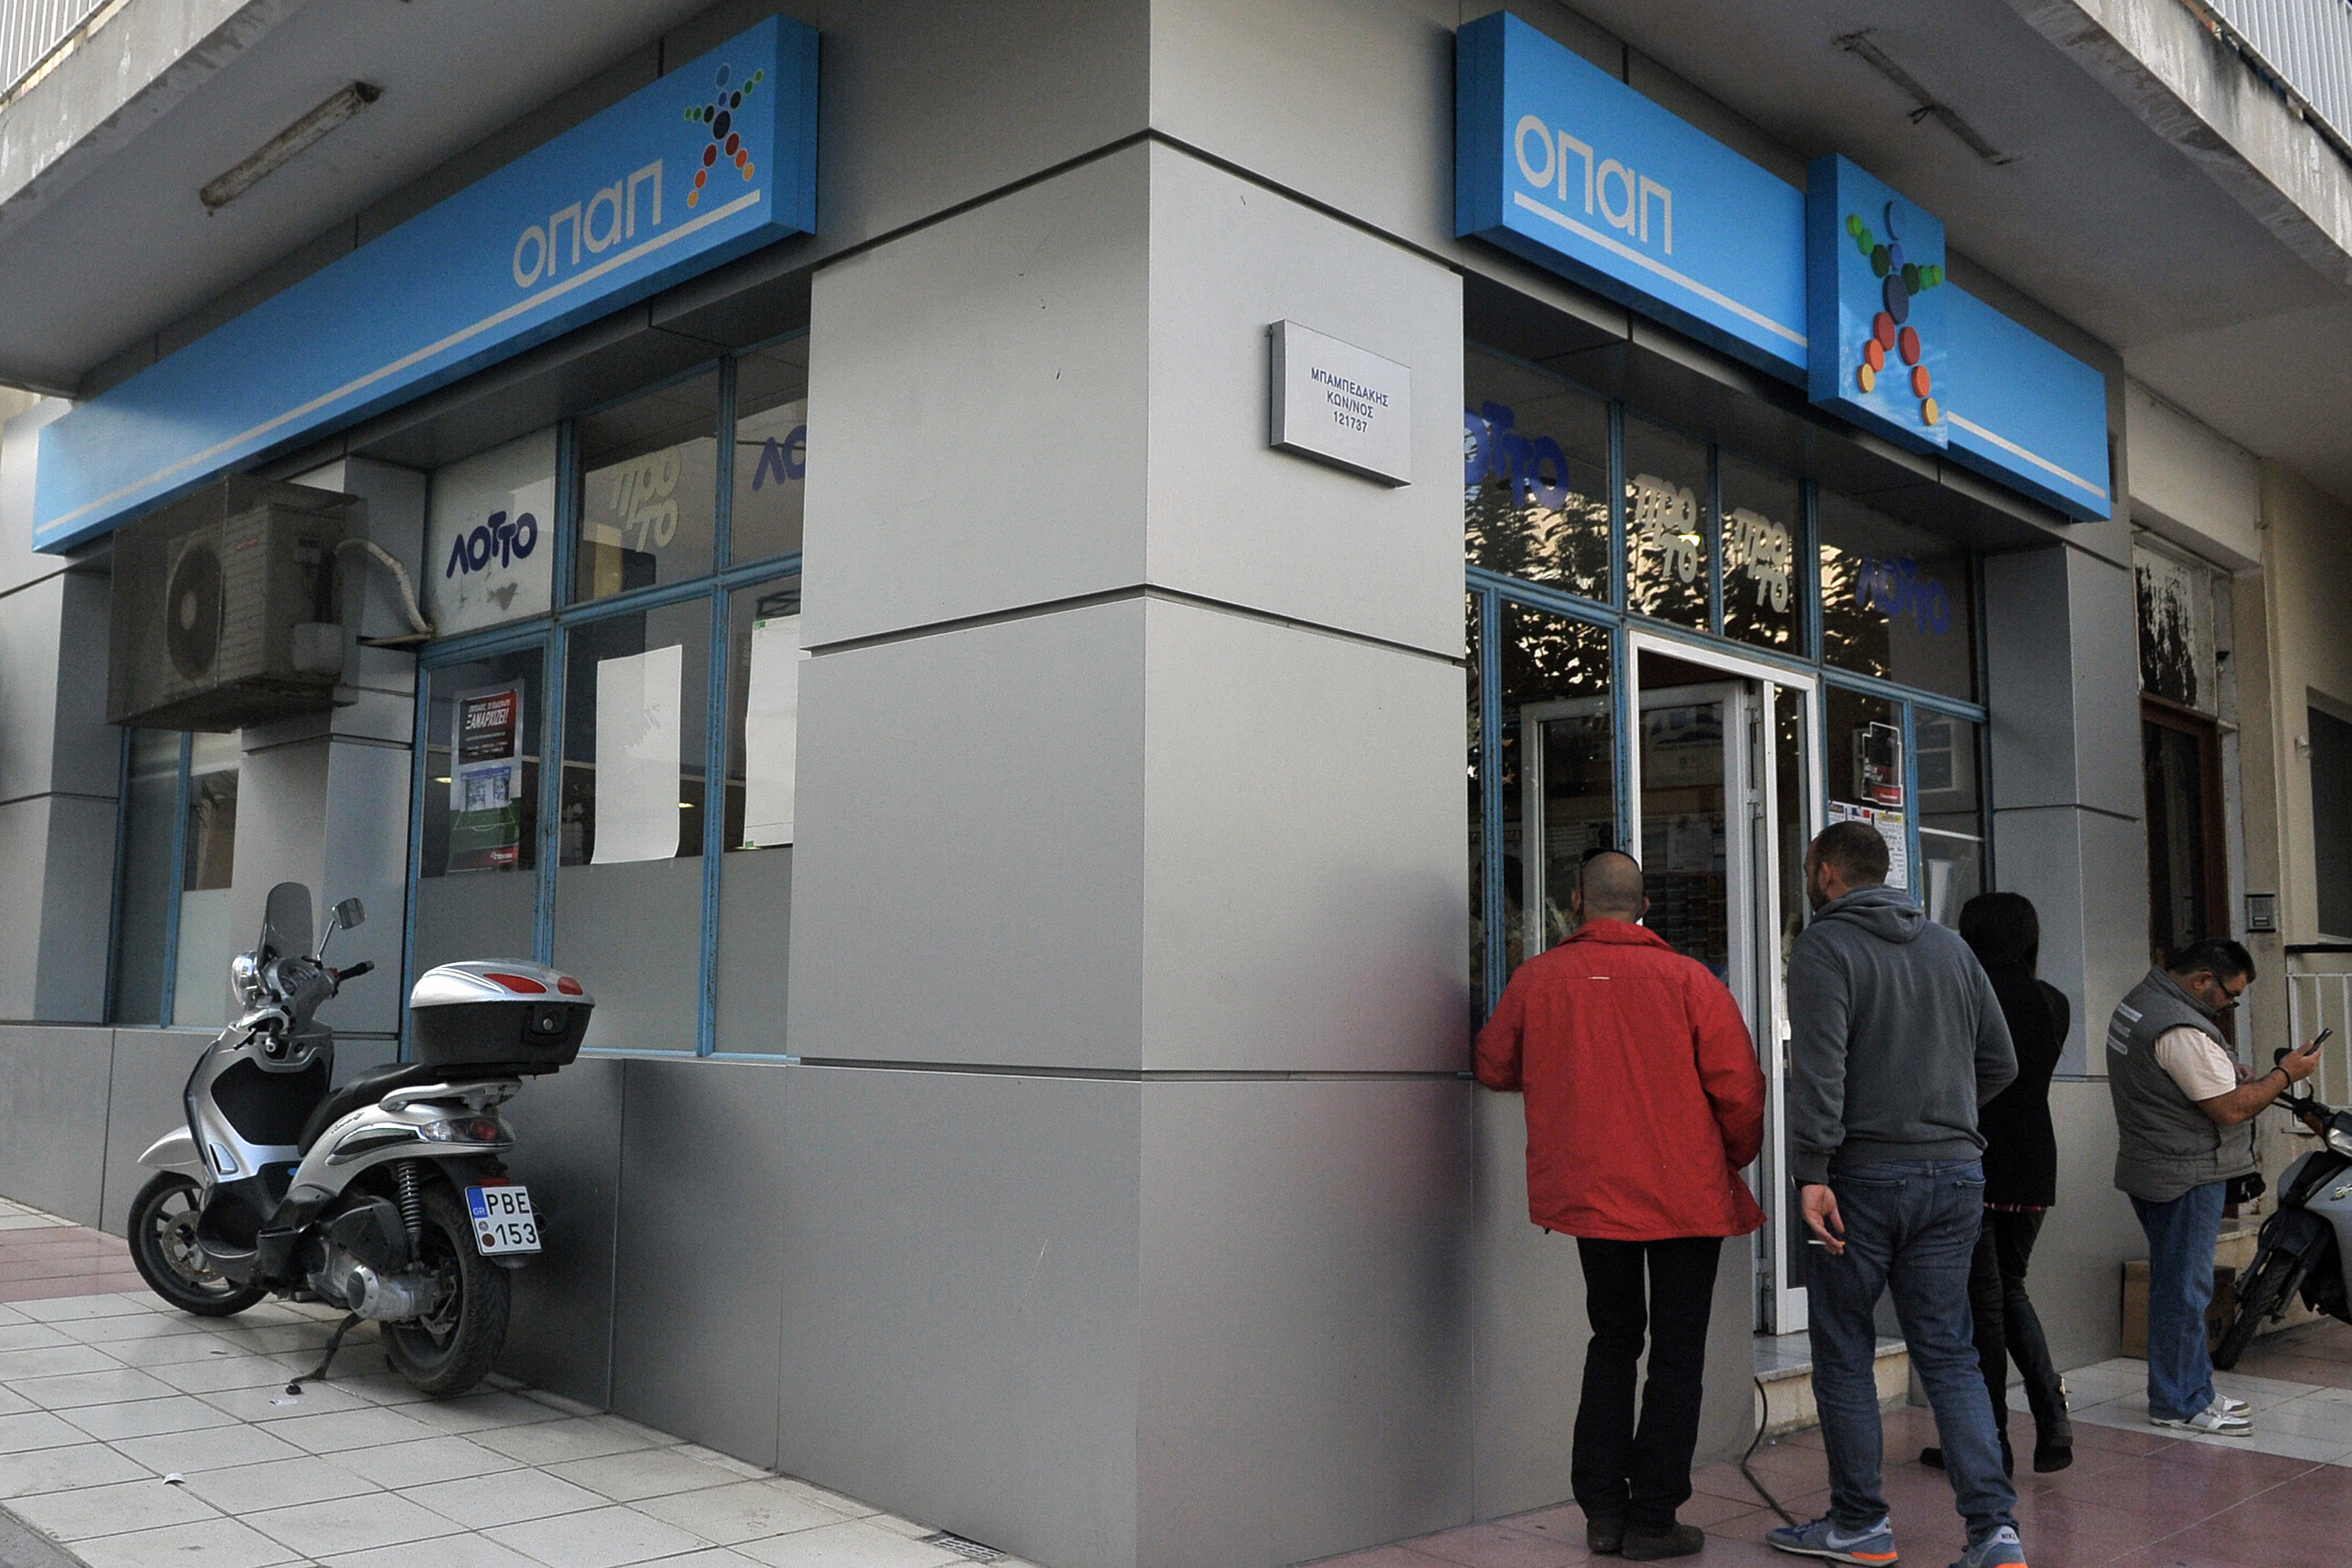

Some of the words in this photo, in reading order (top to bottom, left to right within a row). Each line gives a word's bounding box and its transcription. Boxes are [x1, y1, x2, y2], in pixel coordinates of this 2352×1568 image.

[1311, 367, 1388, 407] ΜΠΑΜΠΕΔΑΚΗΣ
[1327, 390, 1373, 418] ΚΩΝ/ΝΟΣ
[1333, 411, 1368, 433] 121737
[472, 1207, 486, 1215] GR
[495, 1223, 537, 1245] 153
